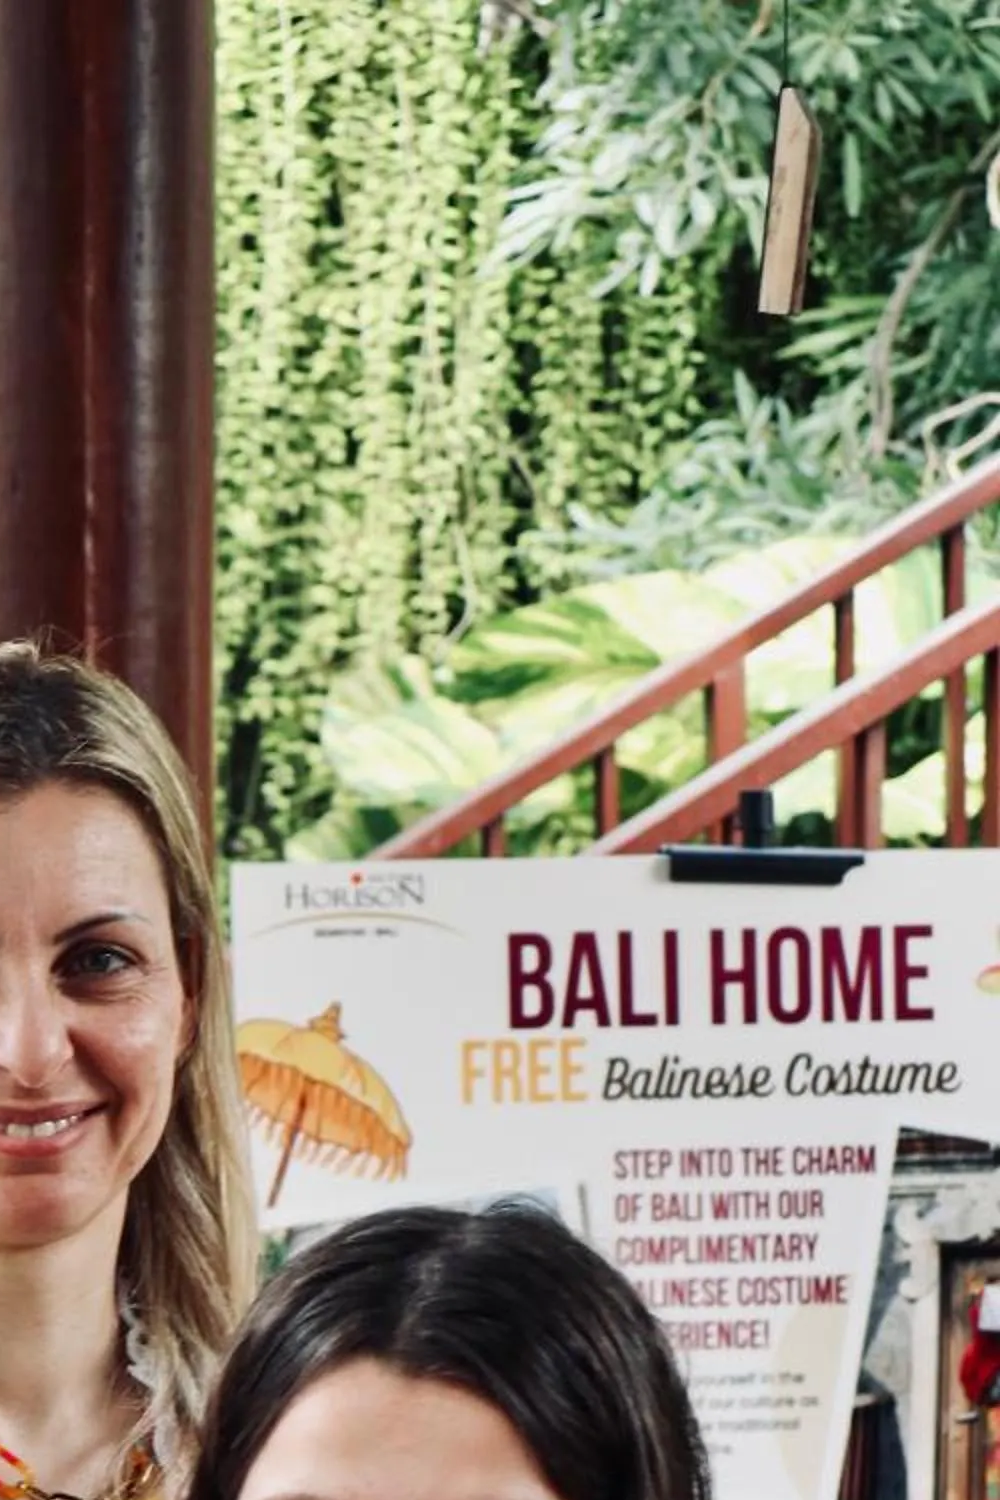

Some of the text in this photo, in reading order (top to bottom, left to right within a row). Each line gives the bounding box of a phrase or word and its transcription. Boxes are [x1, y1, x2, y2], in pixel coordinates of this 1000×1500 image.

[508, 925, 935, 1030] BALI HOME
[460, 1038, 963, 1105] FREE Balinese Costume
[613, 1145, 877, 1180] STEP INTO THE CHARM
[614, 1189, 824, 1224] OF BALI WITH OUR
[615, 1233, 819, 1266] COMPLIMENTARY
[736, 1274, 849, 1306] COSTUME
[664, 1320, 770, 1350] ERIENCE!
